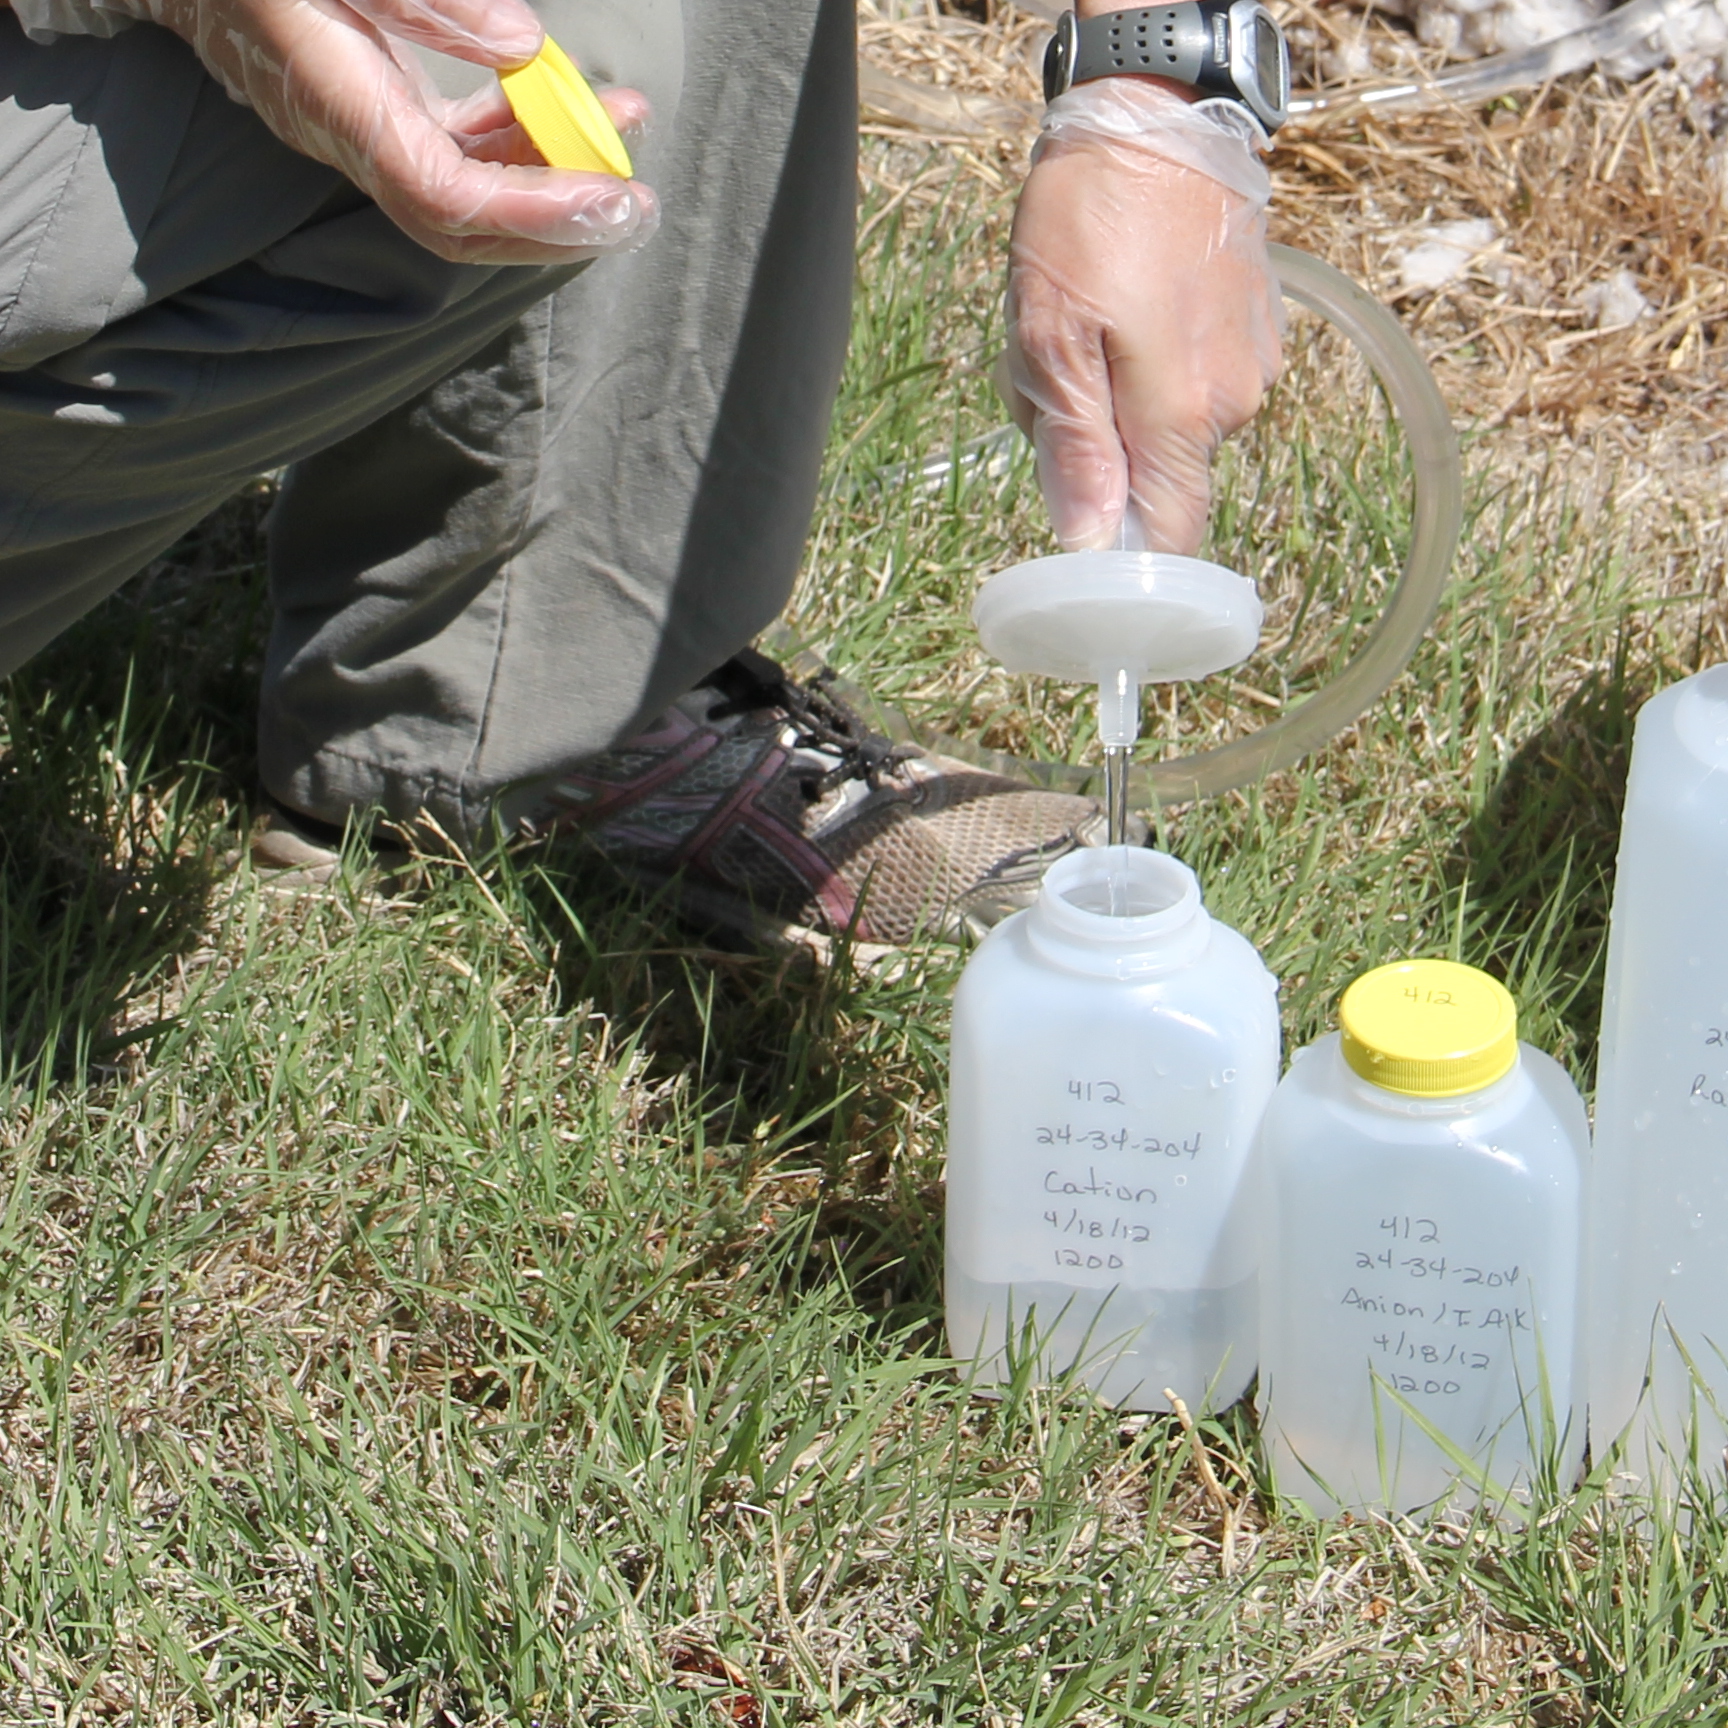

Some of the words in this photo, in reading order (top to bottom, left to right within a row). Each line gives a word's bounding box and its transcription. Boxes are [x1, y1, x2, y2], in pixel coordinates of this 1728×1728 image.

[1403, 986, 1458, 1007] 412
[1068, 1079, 1126, 1105] 412
[1035, 1123, 1202, 1161] 24-34-204
[1044, 1166, 1158, 1205] Cation
[1043, 1208, 1151, 1243] 4/18/12
[1379, 1216, 1441, 1244] 412
[1054, 1248, 1124, 1270] 1200
[1355, 1248, 1520, 1287] 24-34-204
[1373, 1330, 1491, 1370] 4/18/12
[1390, 1373, 1461, 1395] 1200
